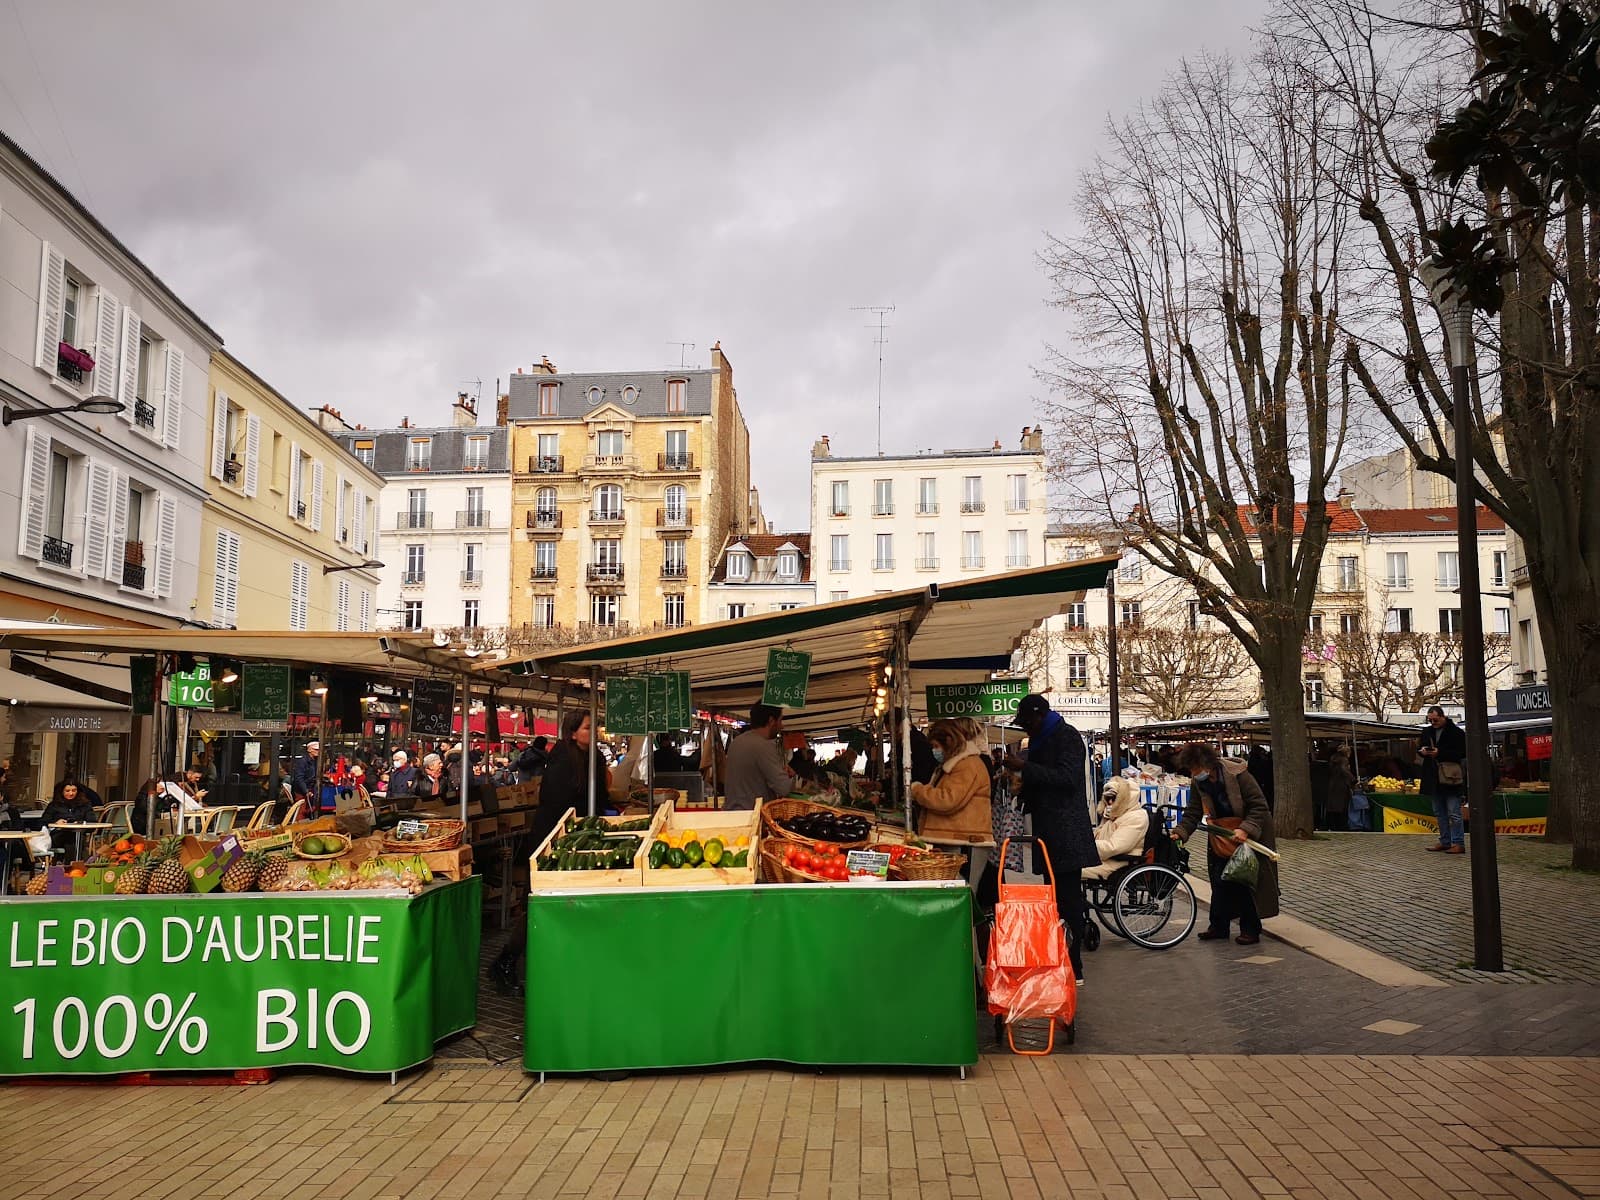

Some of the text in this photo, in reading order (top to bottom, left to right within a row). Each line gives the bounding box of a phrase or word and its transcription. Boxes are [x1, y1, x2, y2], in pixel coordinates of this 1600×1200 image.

[933, 683, 1022, 697] LE BIO D'AURELIE
[936, 700, 982, 714] 100%
[1058, 696, 1104, 705] COIFFURE
[50, 716, 76, 729] SALON
[78, 717, 88, 729] DE
[1388, 818, 1403, 831] VAL
[9, 915, 381, 969] LE BIO D'AURELIE
[12, 987, 372, 1060] 100% BIO
